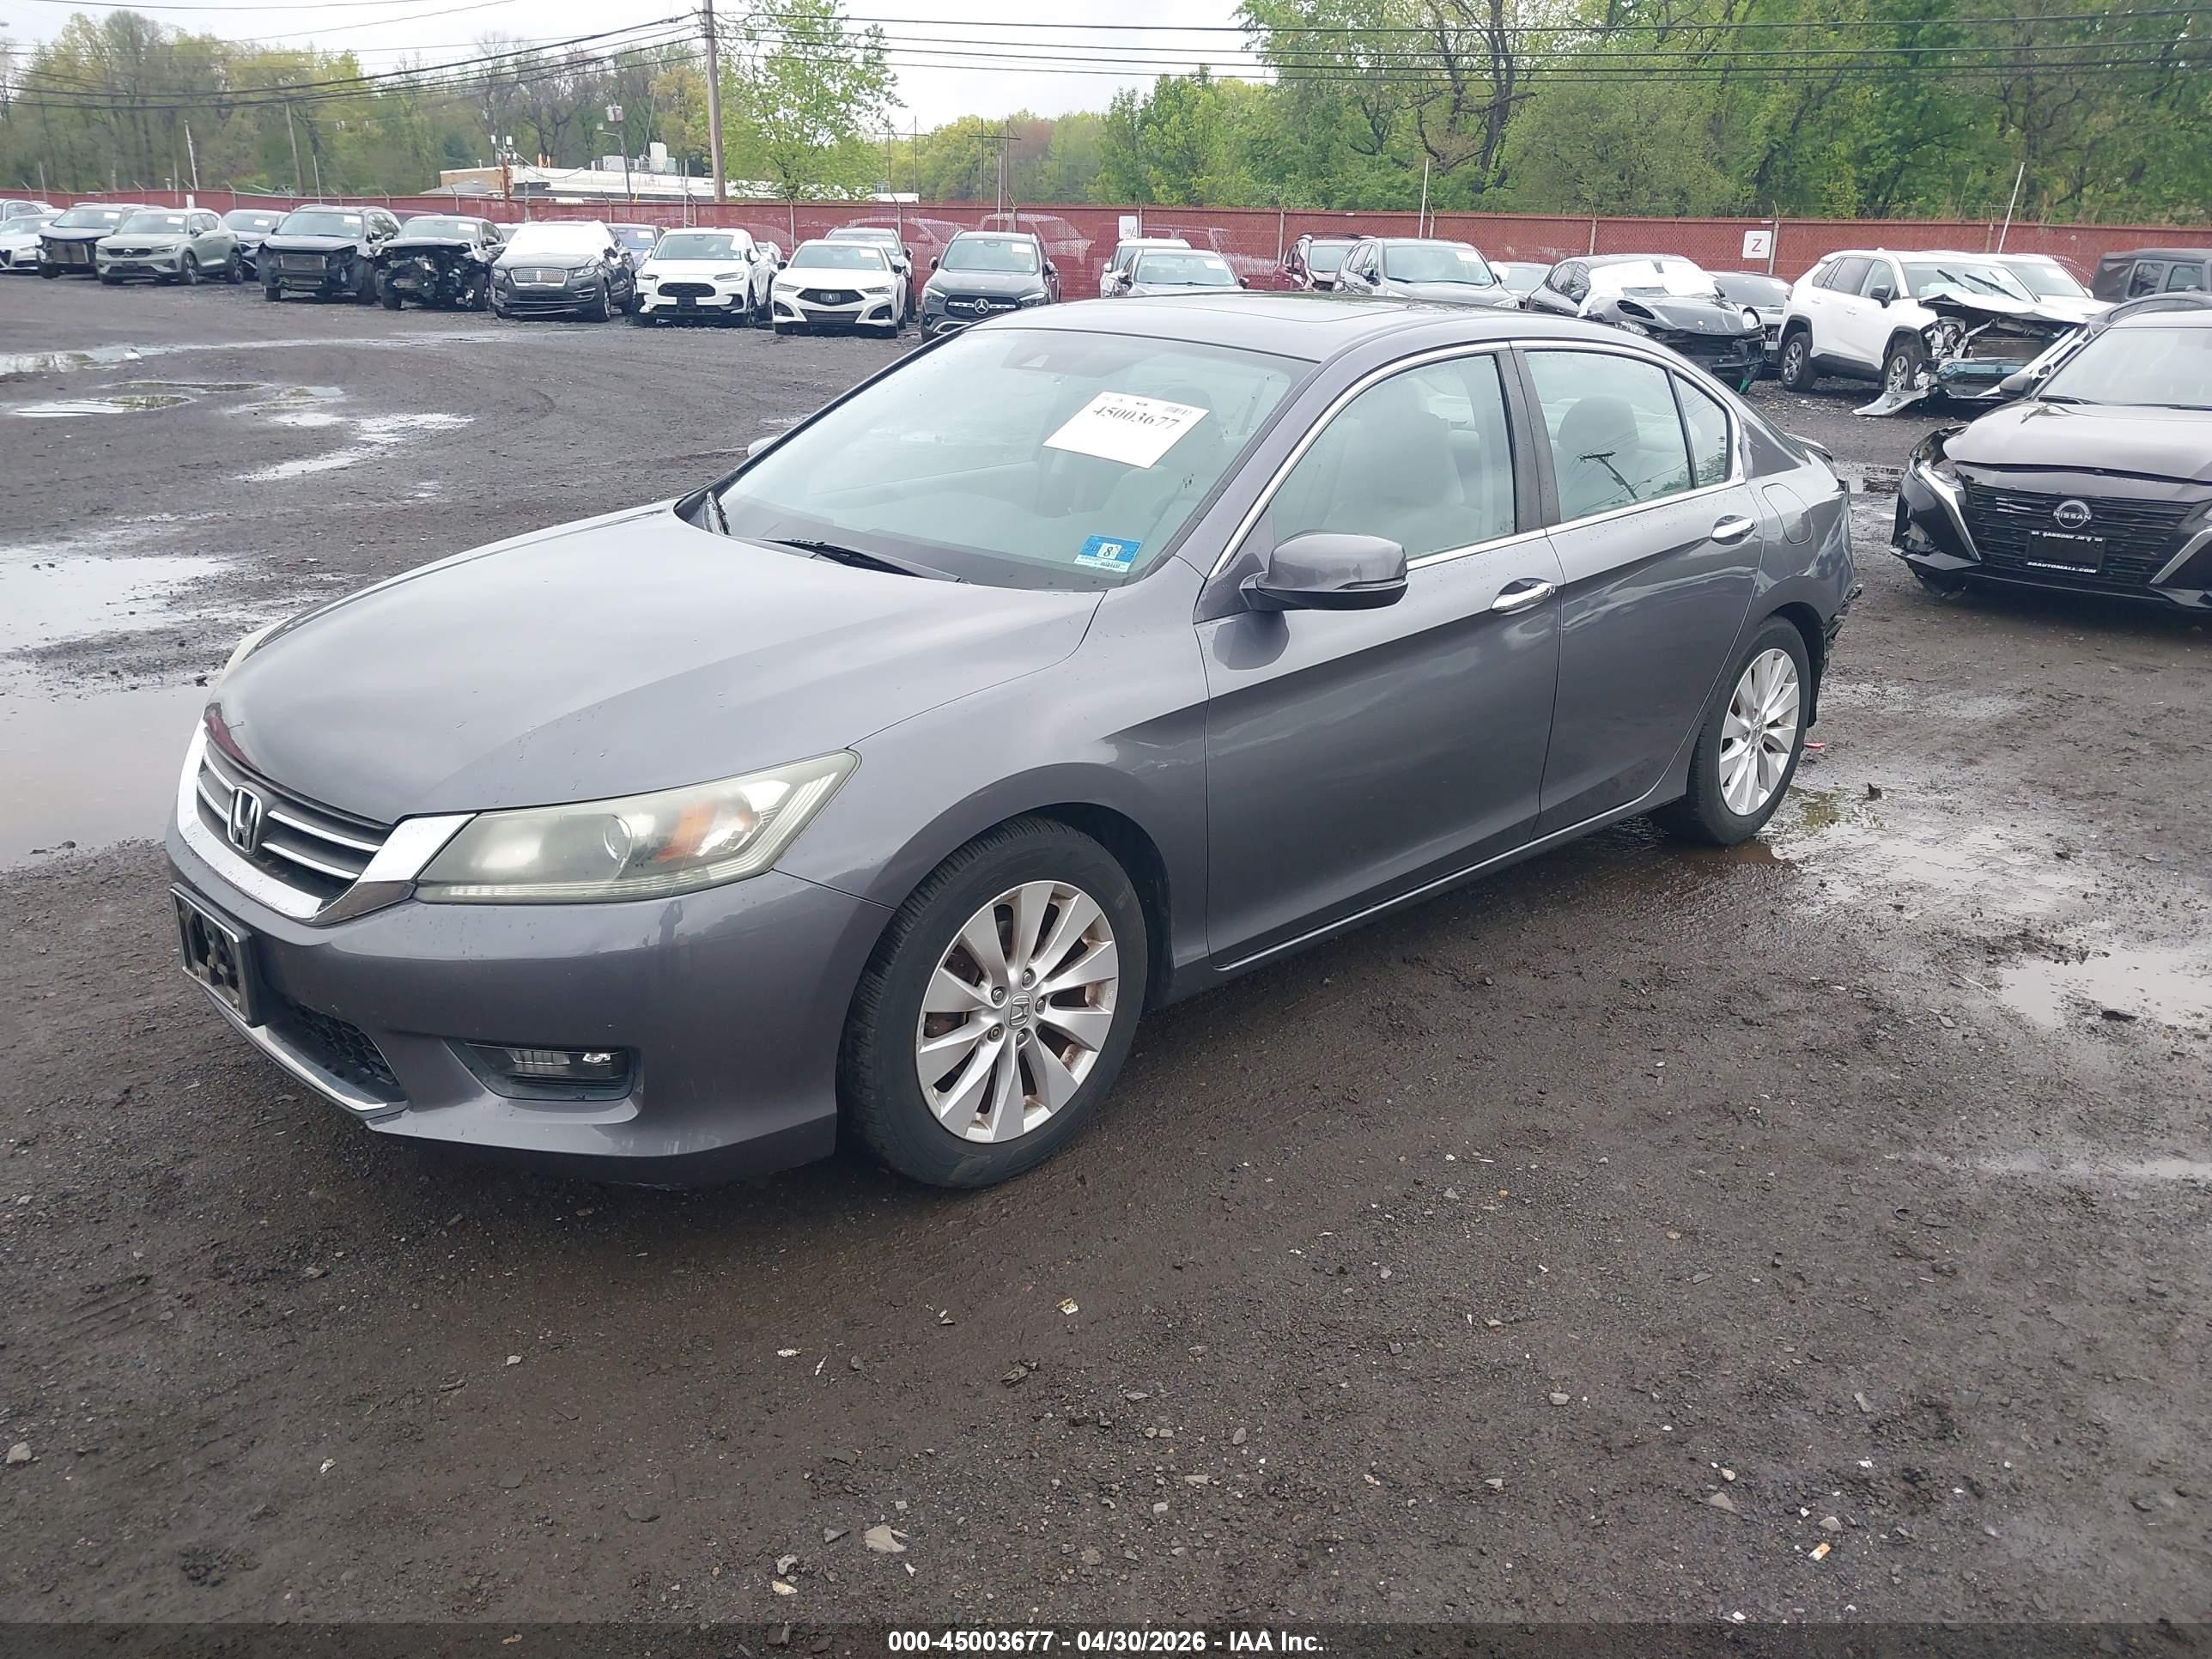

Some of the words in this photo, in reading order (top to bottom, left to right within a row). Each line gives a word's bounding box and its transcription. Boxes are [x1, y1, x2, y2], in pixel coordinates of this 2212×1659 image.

[1752, 239, 1762, 252] Z
[1093, 406, 1180, 428] 45003677
[2053, 511, 2092, 520] NISSAN
[1103, 546, 1113, 556] 8
